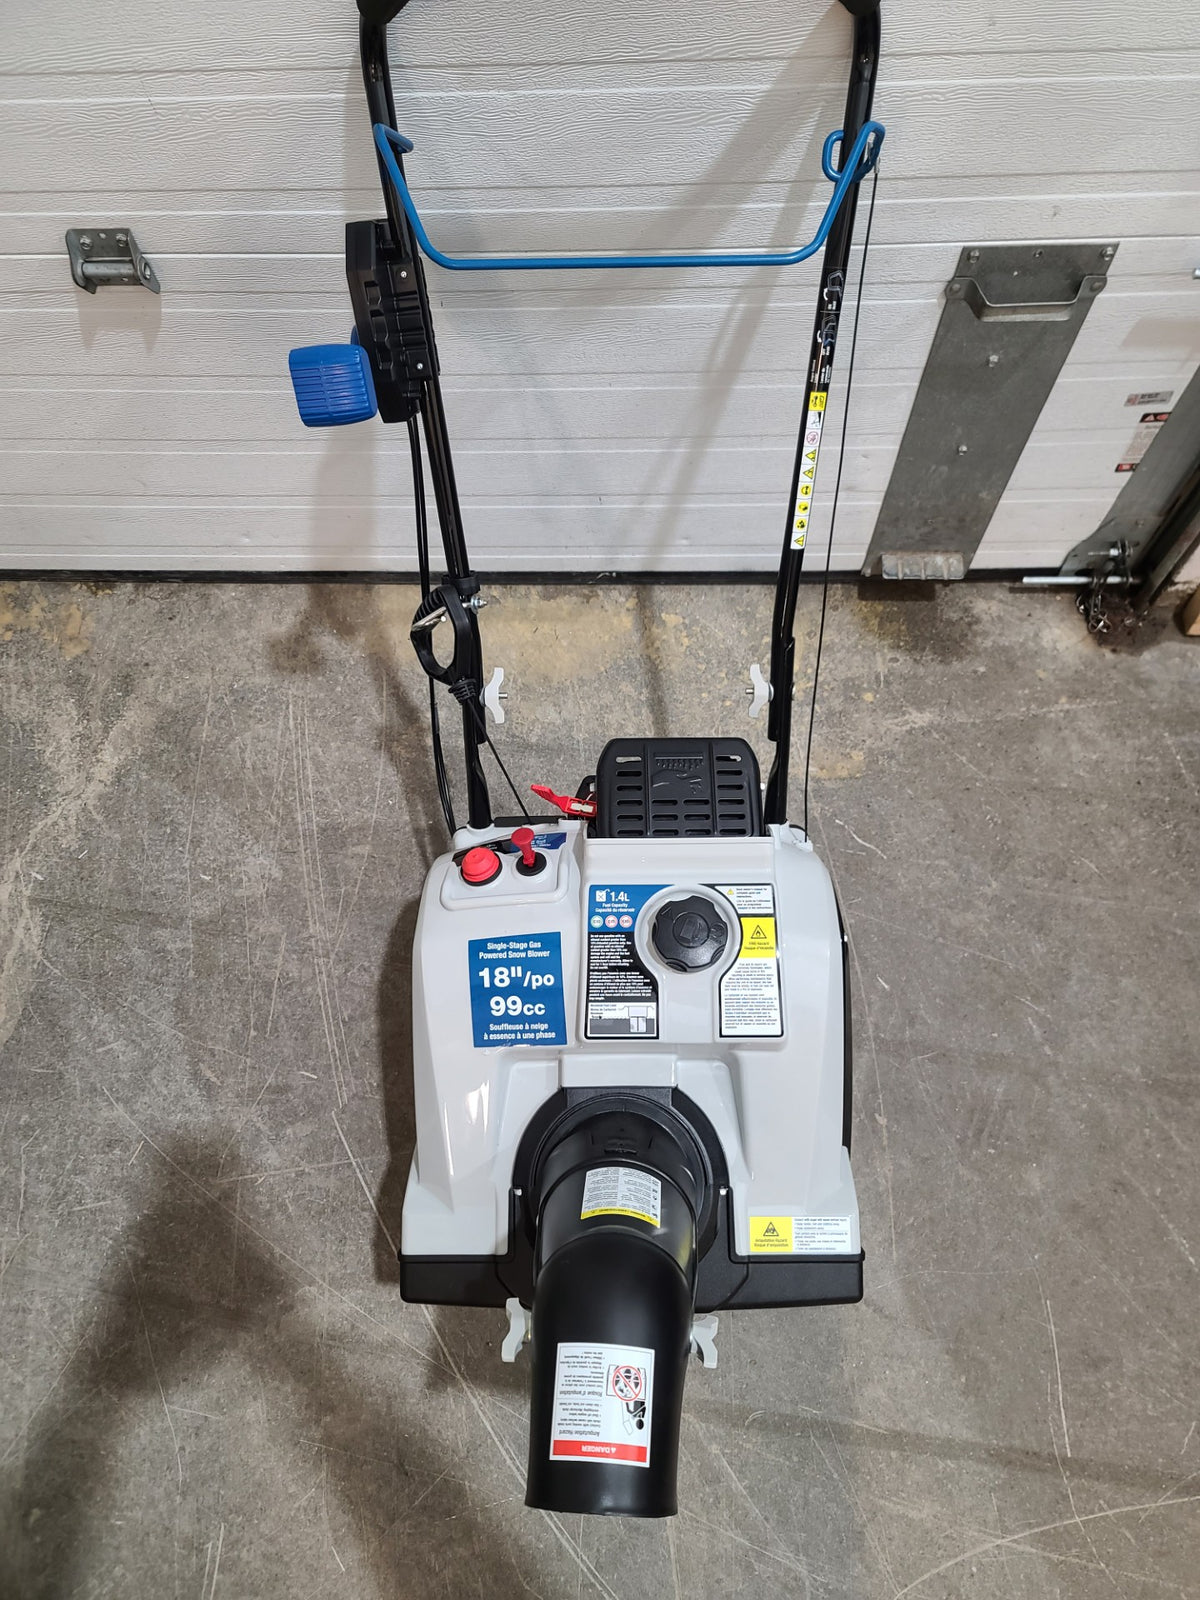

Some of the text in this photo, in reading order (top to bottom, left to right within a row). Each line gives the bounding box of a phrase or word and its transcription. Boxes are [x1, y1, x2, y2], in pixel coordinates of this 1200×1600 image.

[610, 891, 630, 902] 1.4L
[487, 942, 528, 950] Single-Stage
[479, 952, 507, 960] Powered
[479, 966, 554, 990] 18"/po
[490, 996, 546, 1016] 99cc
[524, 1022, 530, 1030] à
[531, 1022, 548, 1030] neige
[536, 1032, 556, 1040] phase
[574, 1430, 600, 1438] Amputation
[582, 1444, 610, 1454] DANGER
